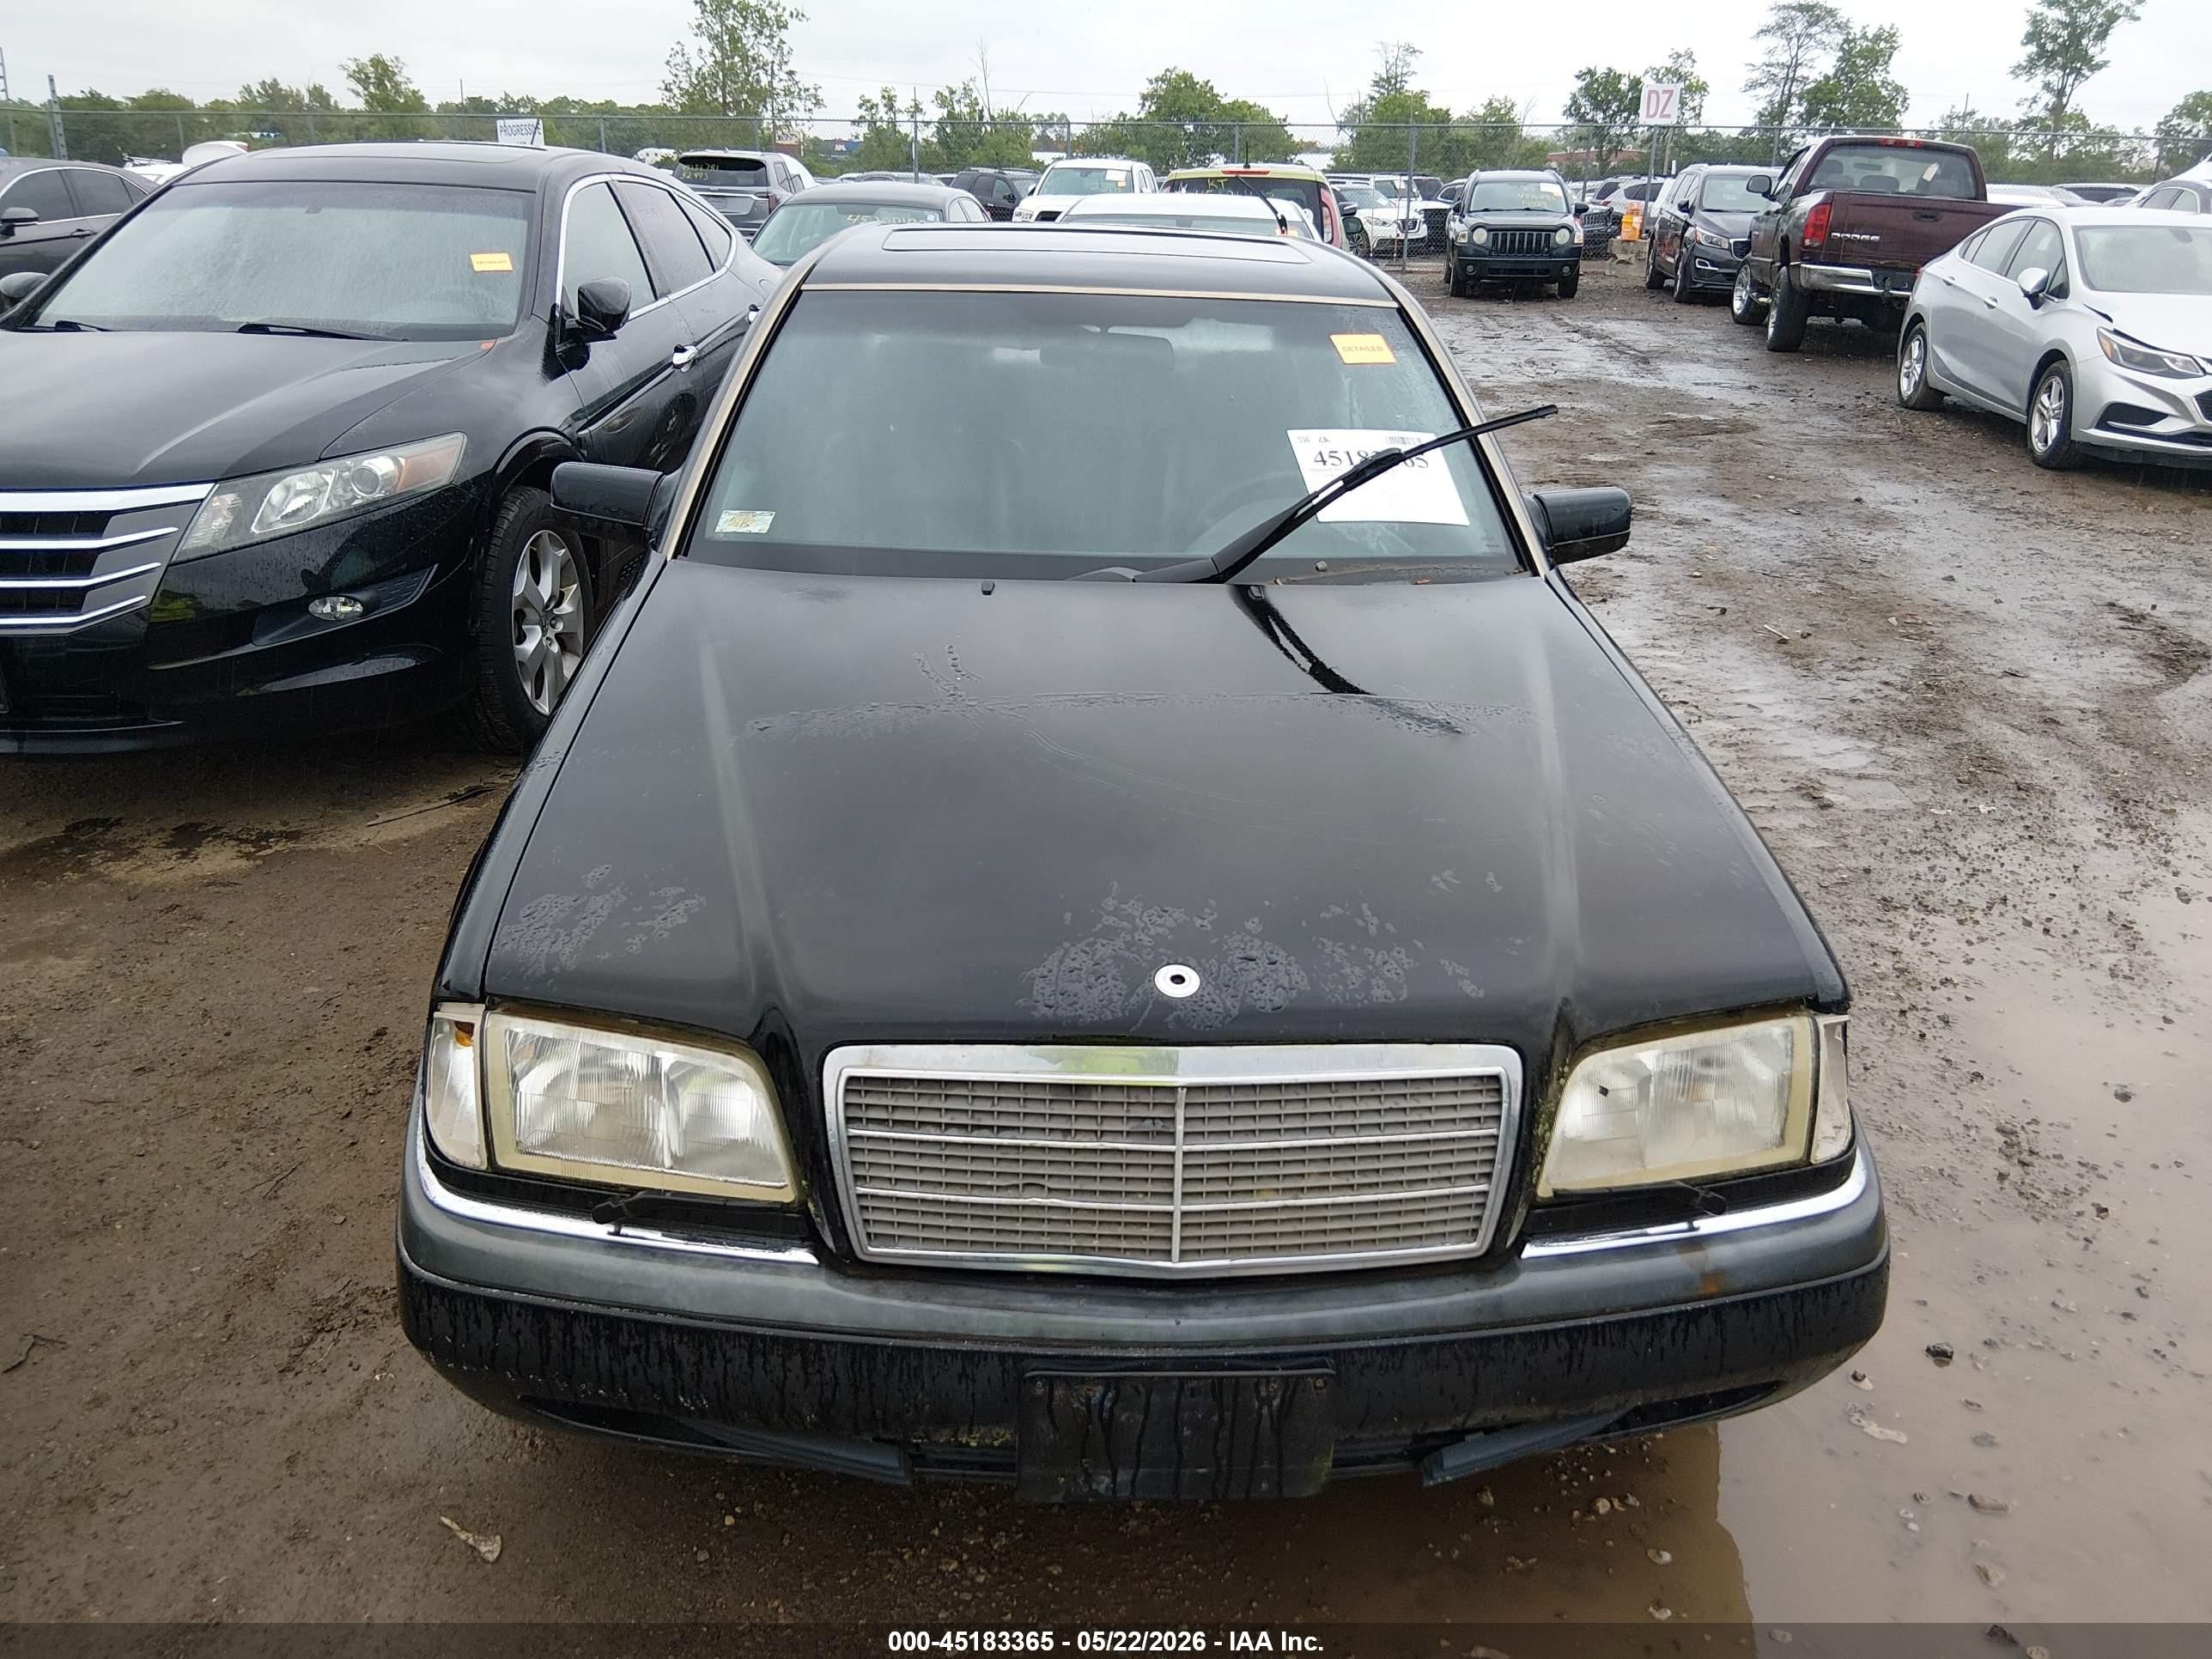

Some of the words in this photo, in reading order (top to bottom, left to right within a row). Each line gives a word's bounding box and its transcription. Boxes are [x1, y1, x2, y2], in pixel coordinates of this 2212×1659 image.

[1645, 89, 1674, 118] DZ
[500, 123, 541, 137] PROGRESSIE
[1831, 233, 1881, 242] DODGE
